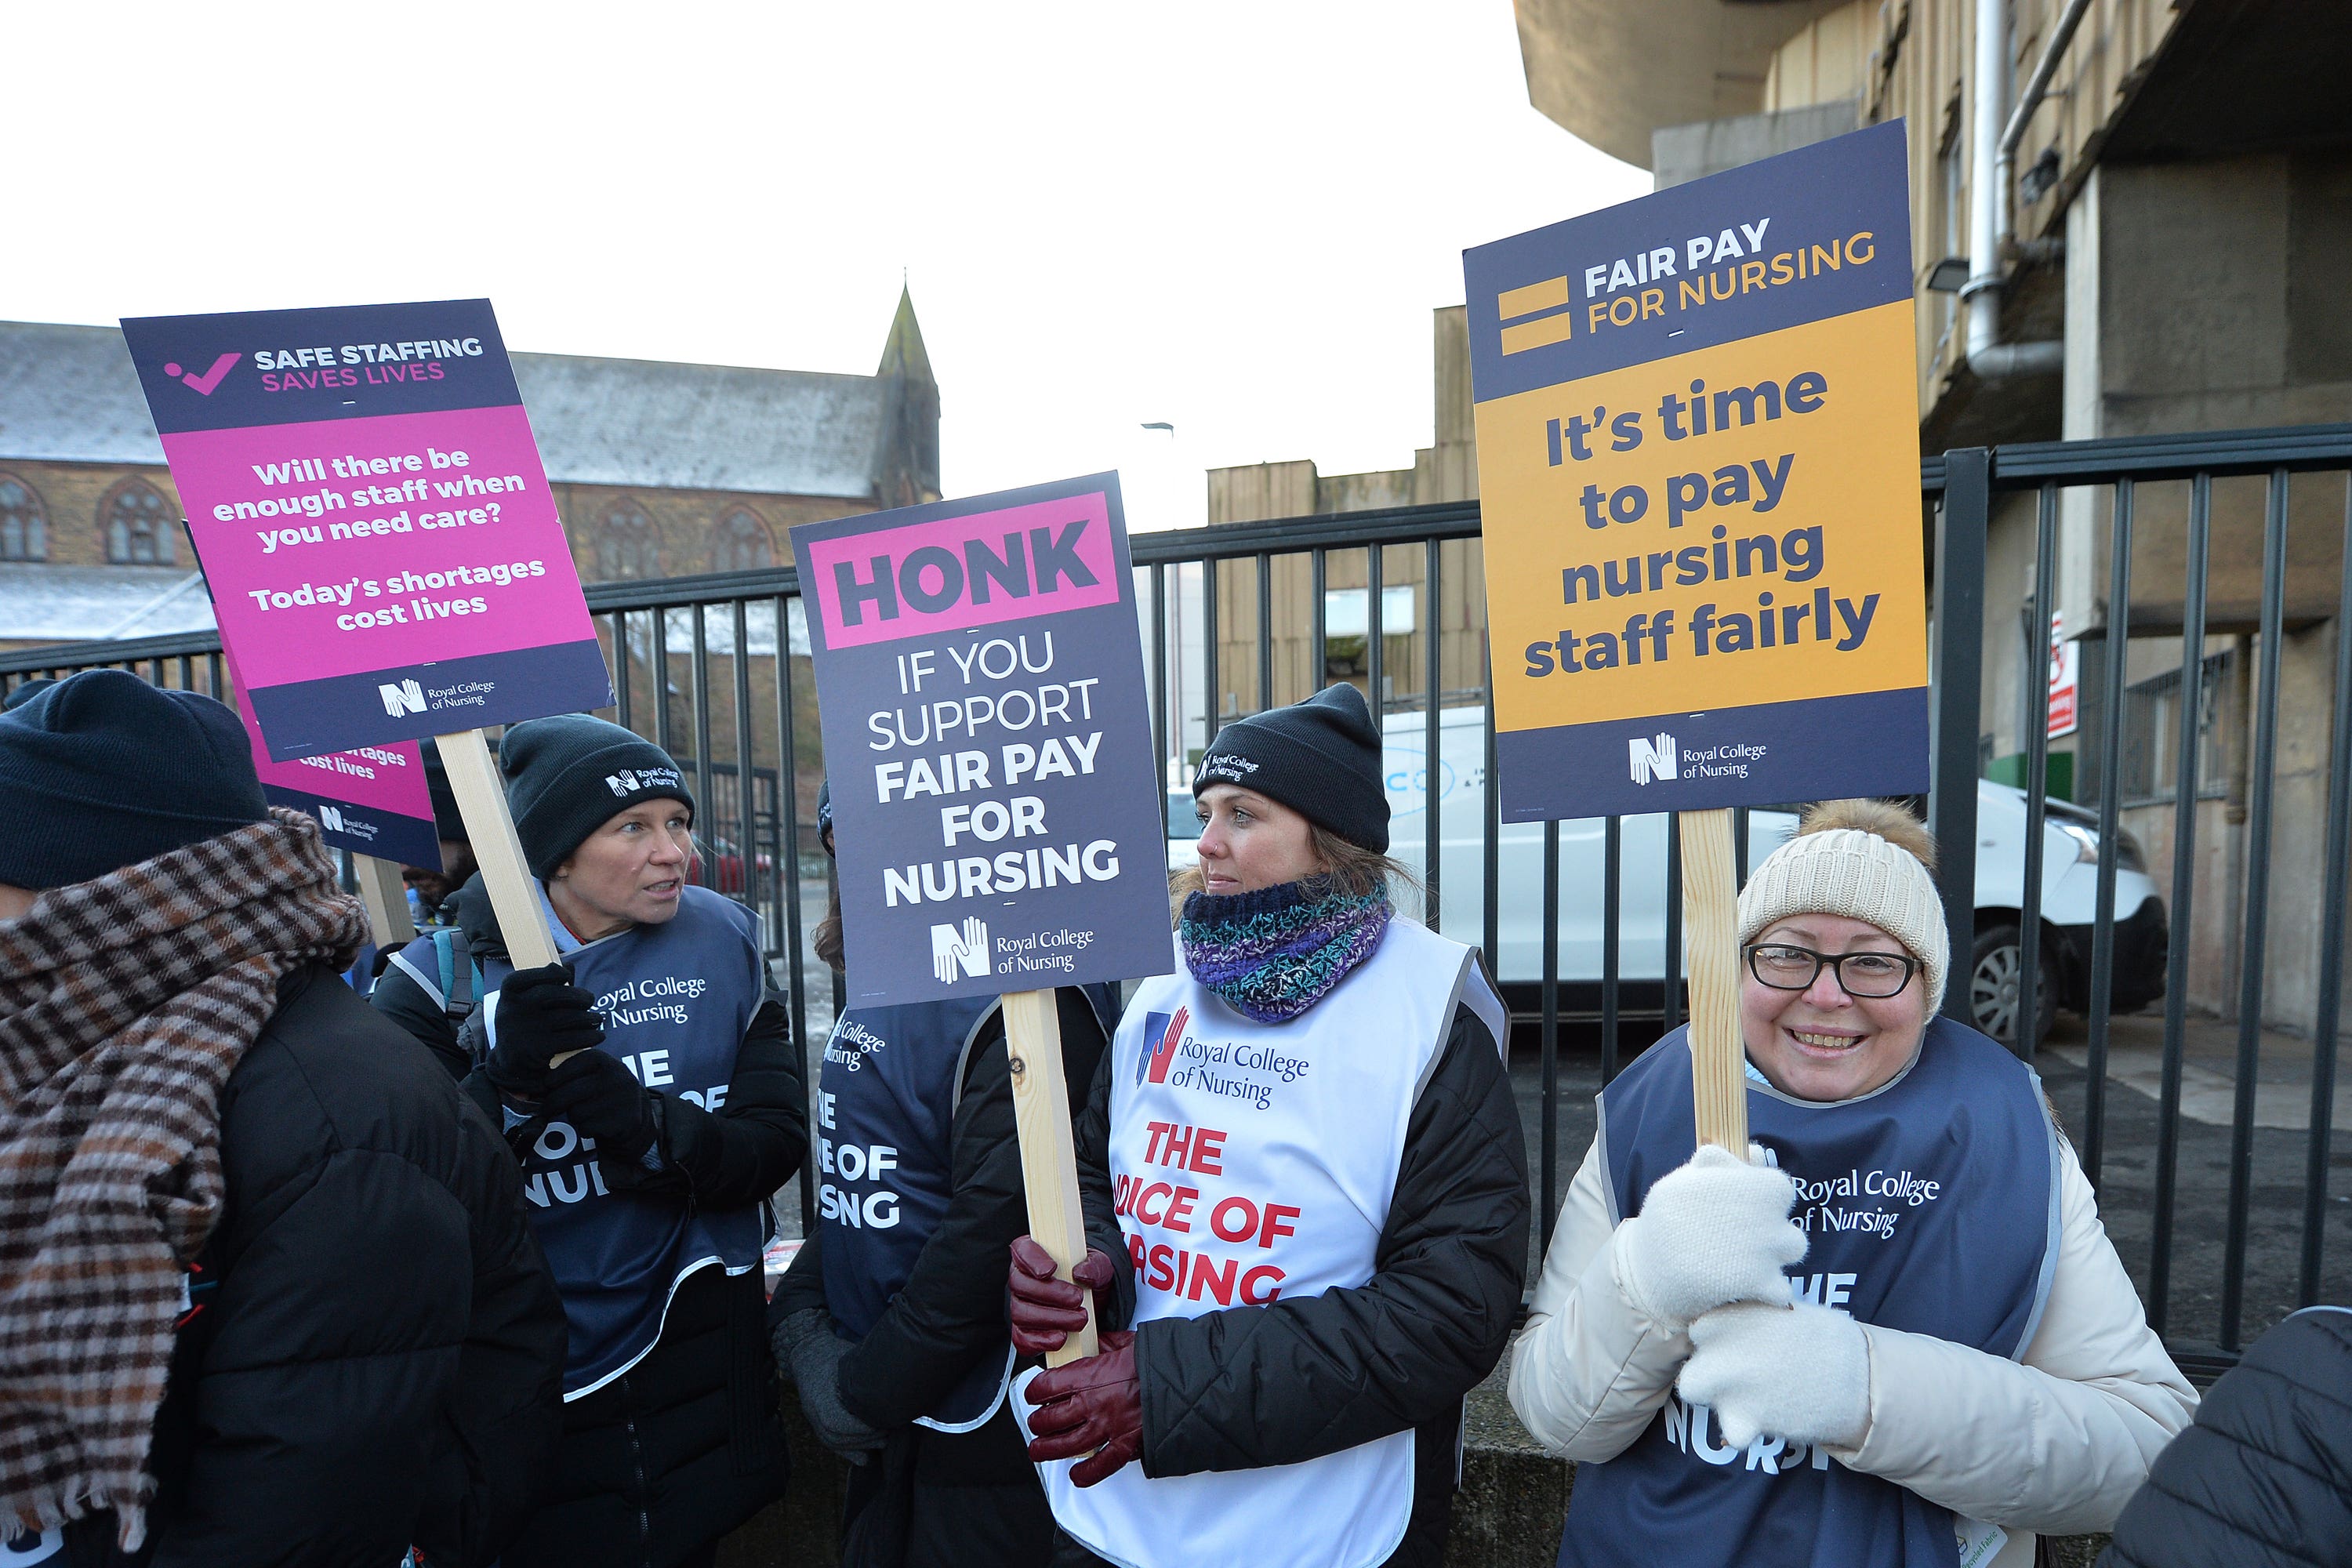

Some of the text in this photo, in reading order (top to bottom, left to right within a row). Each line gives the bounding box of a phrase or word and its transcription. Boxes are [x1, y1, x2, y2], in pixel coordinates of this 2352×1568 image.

[1585, 217, 1772, 298] FAIR PAY
[1588, 231, 1876, 333] FOR NURSING
[255, 337, 484, 371] SAFE STAFFING
[261, 362, 445, 392] SAVES LIVES
[1545, 371, 1828, 467] It's time
[252, 448, 470, 487] Will there be
[212, 471, 526, 522] enough staff when
[1580, 453, 1795, 531] to pay
[256, 503, 502, 554] you need care?
[833, 519, 1100, 627] HONK
[1563, 525, 1824, 604] nursing
[249, 560, 546, 612] Today's shortages
[336, 594, 488, 632] cost lives
[1525, 586, 1881, 677] staff fairly
[897, 630, 1053, 695] IF YOU
[428, 680, 495, 699] Royal College
[432, 693, 485, 709] of Nursing
[868, 677, 1098, 750] SUPPORT
[336, 757, 376, 779] lives
[874, 731, 1102, 803] FAIR PAY
[1212, 754, 1258, 772] Royal College
[1682, 742, 1766, 764] Royal College
[1684, 760, 1749, 779] of Nursing
[636, 768, 658, 779] Royal
[643, 779, 650, 787] of
[1216, 764, 1243, 782] Nursing
[941, 796, 1047, 847] FOR
[884, 839, 1120, 907] NURSING
[996, 927, 1094, 957] Royal College
[999, 951, 1075, 972] of Nursing
[587, 977, 706, 1013] oyal College
[612, 1004, 688, 1029] Nursing
[841, 1021, 886, 1053] College
[1181, 1036, 1309, 1083] Royal College
[1173, 1067, 1272, 1110] of Nursing
[837, 1144, 898, 1181] OF
[1144, 1121, 1228, 1176] THE
[1792, 1170, 1940, 1208] Royal College
[1210, 1196, 1301, 1249] OF
[1821, 1207, 1898, 1240] Nursing
[1981, 1531, 1998, 1549] Fabric
